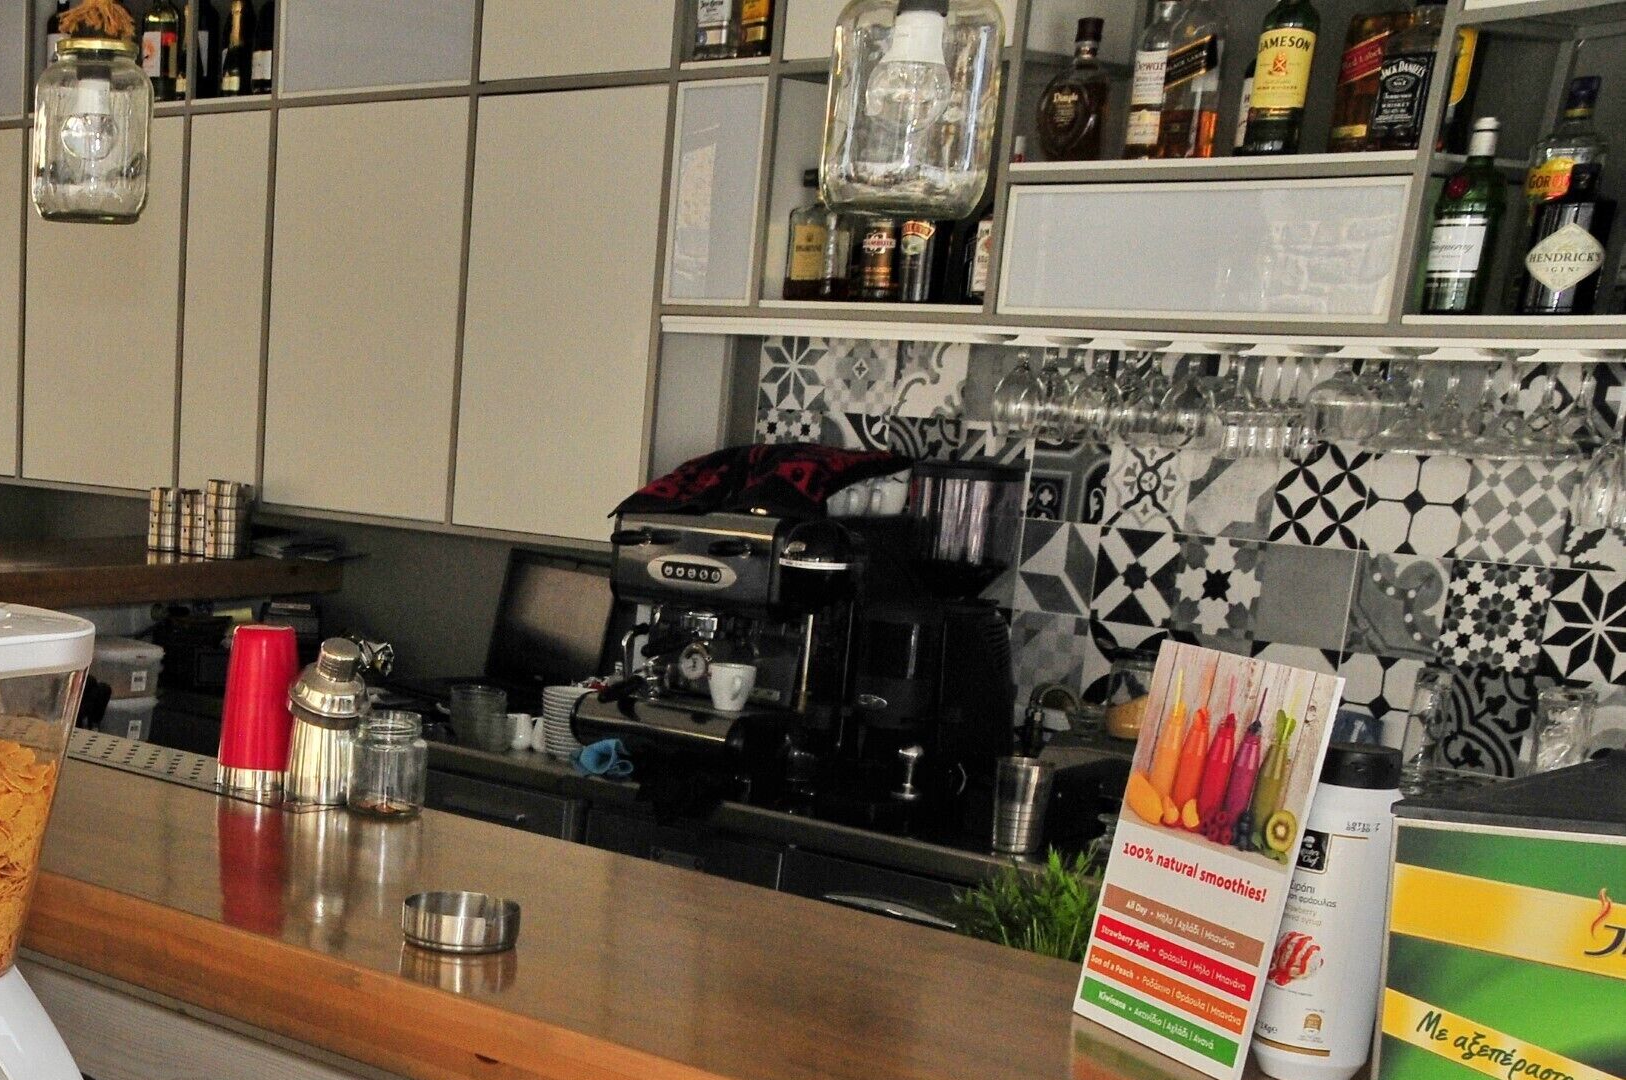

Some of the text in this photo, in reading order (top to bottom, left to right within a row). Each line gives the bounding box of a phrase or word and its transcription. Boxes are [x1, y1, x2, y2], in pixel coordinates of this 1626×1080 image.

[1259, 36, 1311, 53] JAMESON
[1380, 66, 1398, 80] JACK
[1529, 251, 1602, 264] HENDRICK'S
[1122, 842, 1268, 904] 100% natural smoothies!
[1134, 904, 1148, 916] Day
[1100, 925, 1134, 945] Strawberry
[1134, 938, 1150, 952] Split
[1583, 924, 1626, 957] J
[1090, 955, 1102, 966] Son
[1102, 958, 1111, 969] of
[1114, 965, 1134, 979] Peach
[1416, 1010, 1448, 1041] Με
